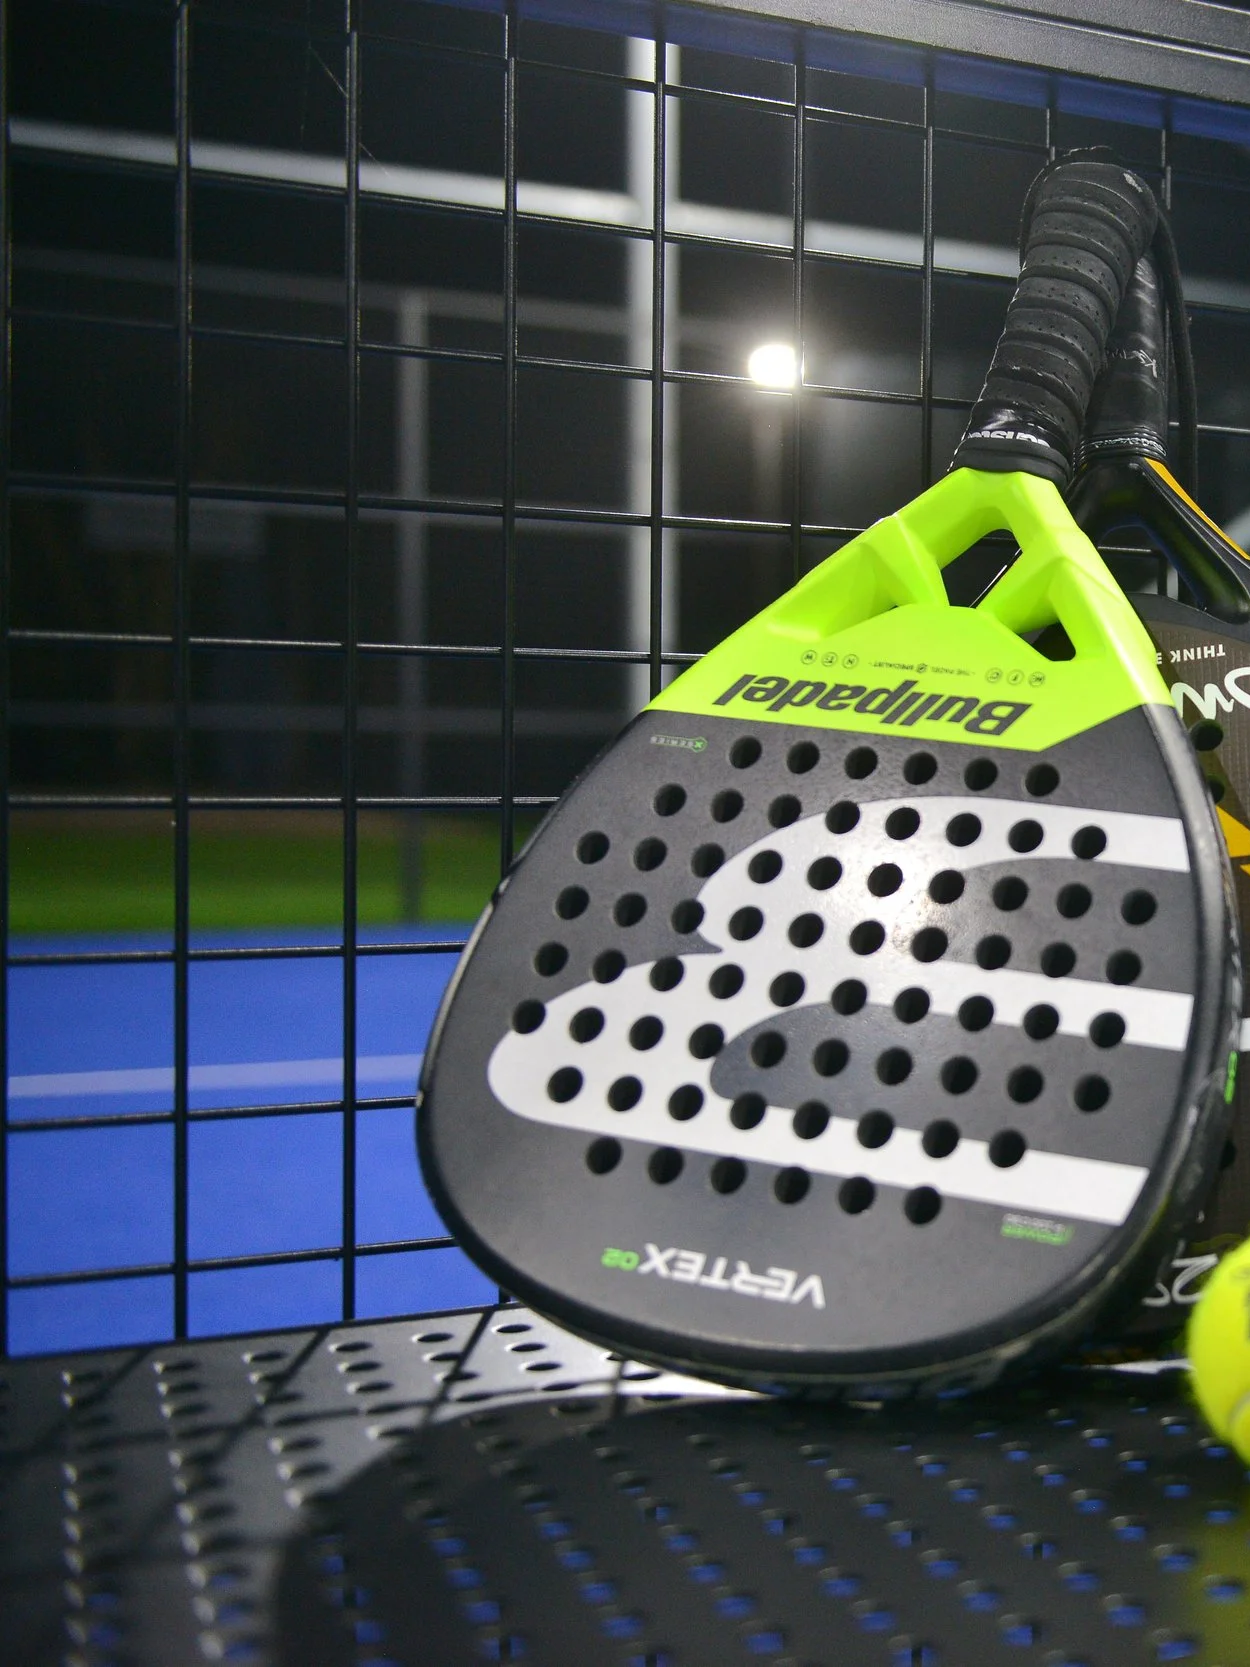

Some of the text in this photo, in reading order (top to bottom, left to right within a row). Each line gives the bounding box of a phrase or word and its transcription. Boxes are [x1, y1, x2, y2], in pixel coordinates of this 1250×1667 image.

[1169, 642, 1227, 664] THINK
[711, 673, 1033, 736] Bullpadel
[637, 1242, 827, 1310] VERTEX
